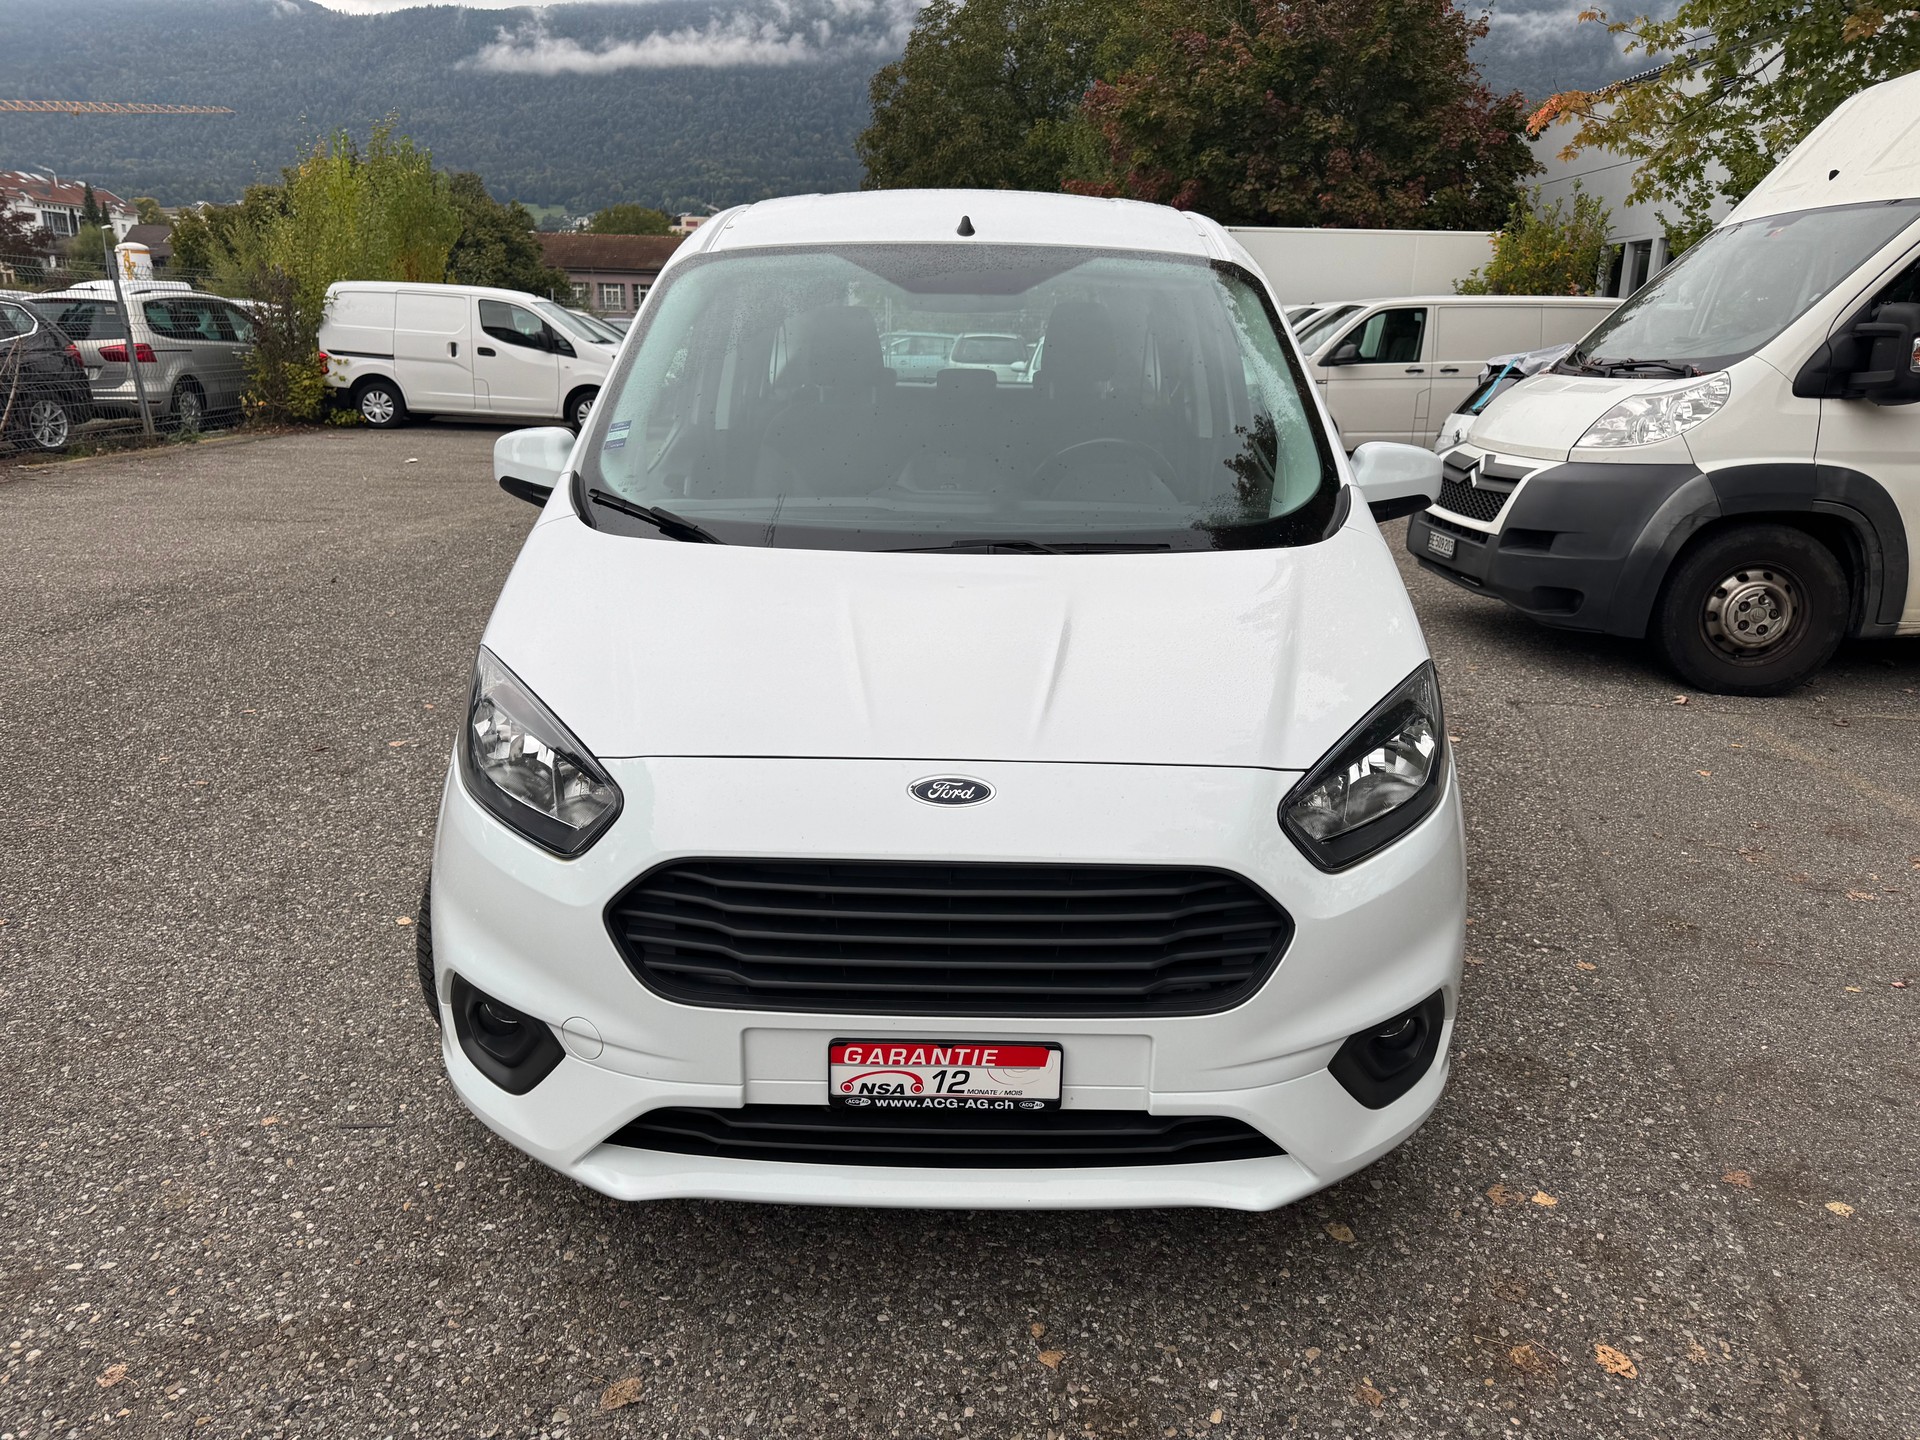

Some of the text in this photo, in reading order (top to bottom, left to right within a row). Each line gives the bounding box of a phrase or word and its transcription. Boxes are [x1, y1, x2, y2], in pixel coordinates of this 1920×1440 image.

[927, 781, 976, 799] Ford
[843, 1047, 999, 1067] GARANTIE
[858, 1082, 905, 1096] NSA
[932, 1069, 971, 1095] 12
[875, 1098, 1014, 1110] www.ACG-AG.ch
